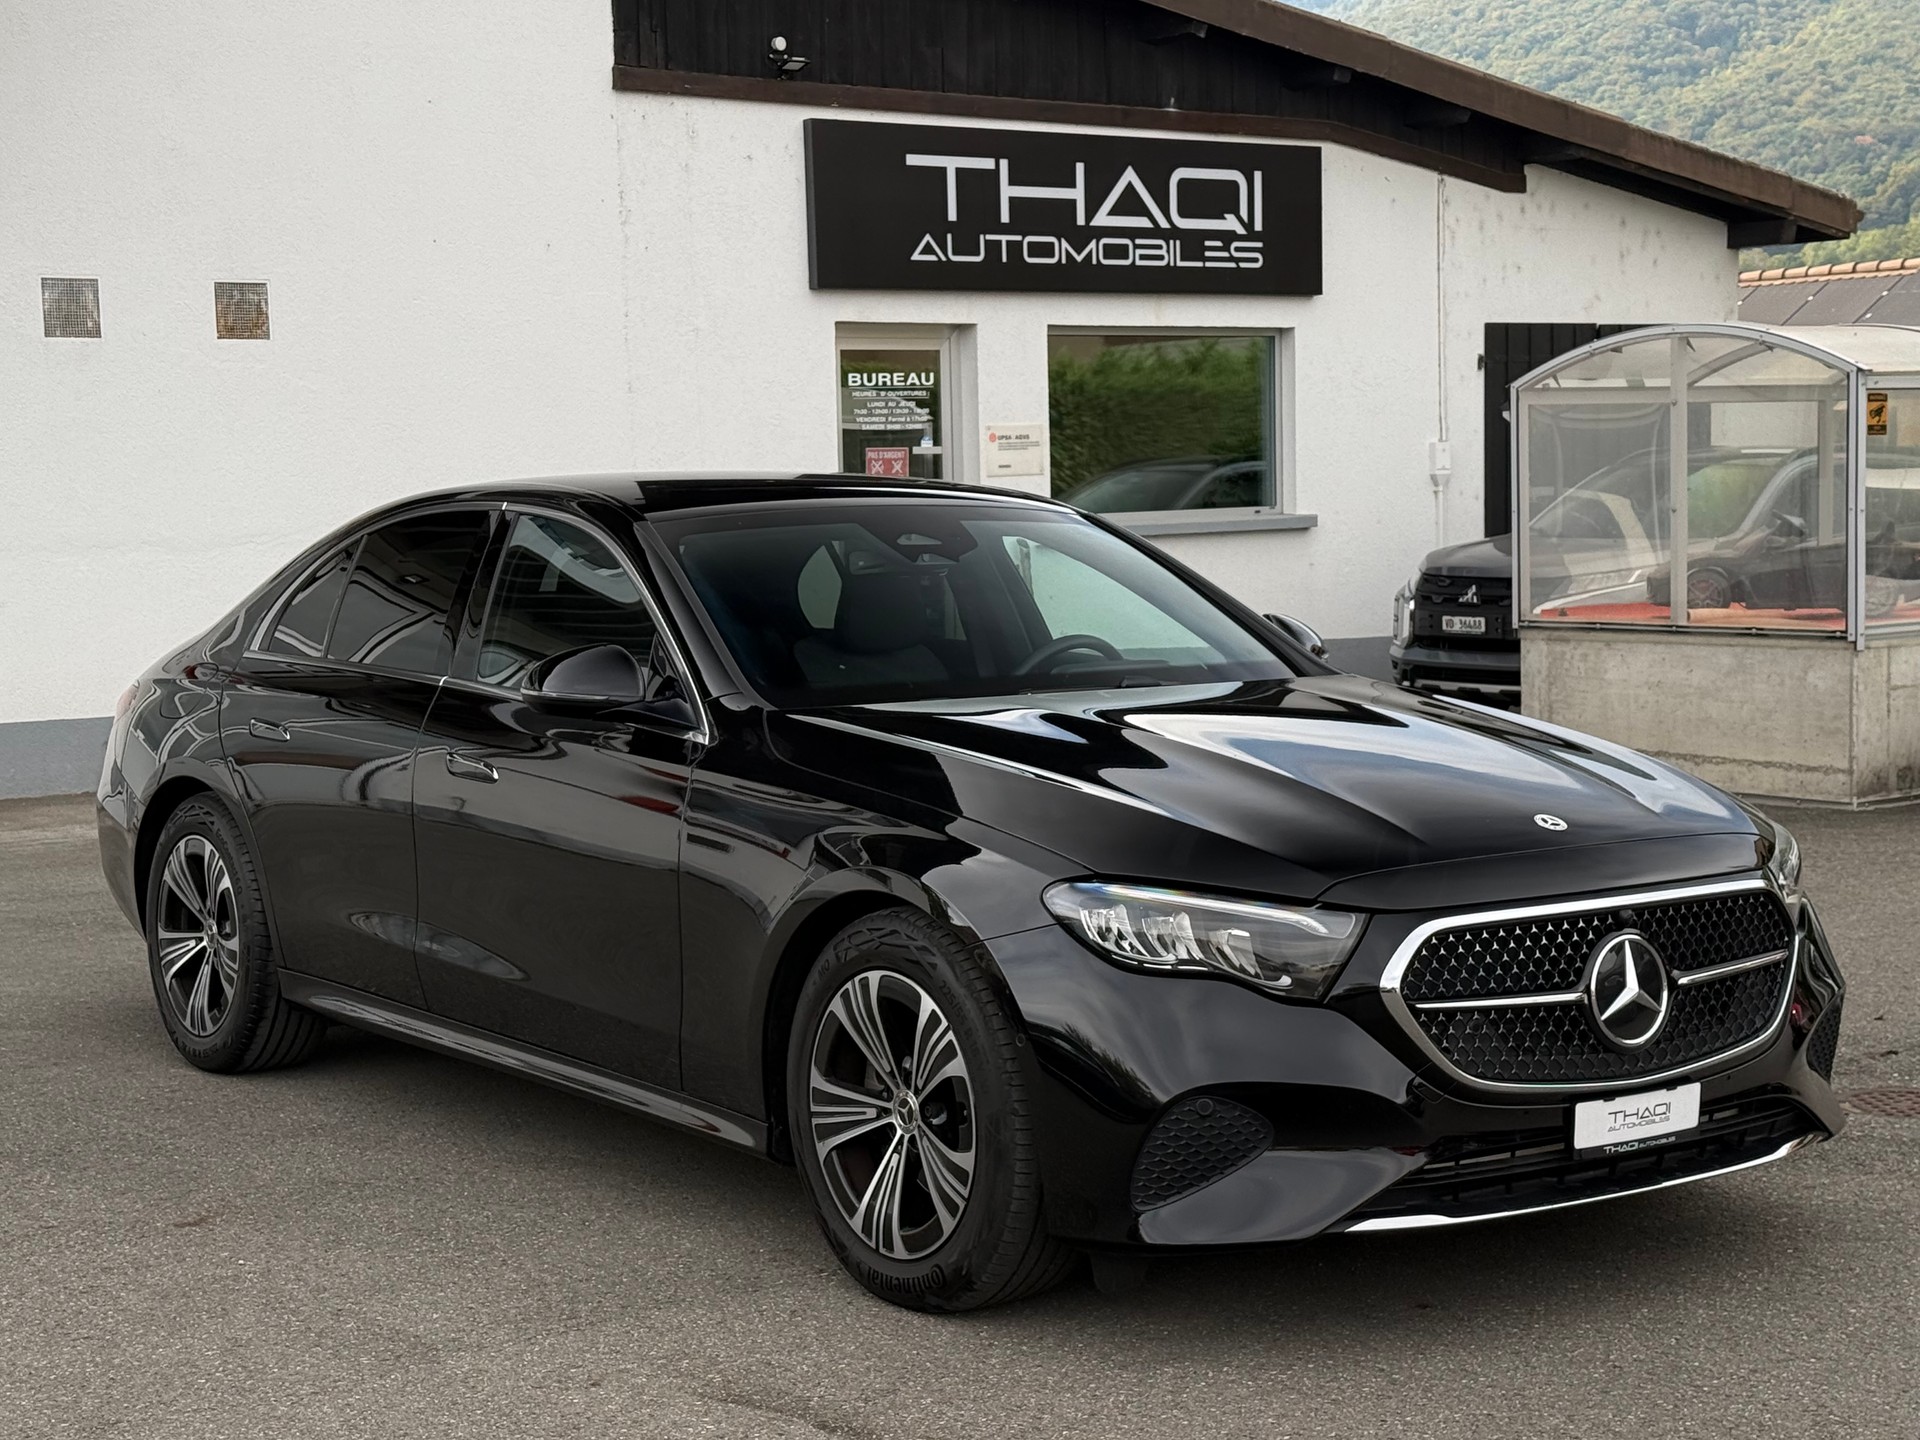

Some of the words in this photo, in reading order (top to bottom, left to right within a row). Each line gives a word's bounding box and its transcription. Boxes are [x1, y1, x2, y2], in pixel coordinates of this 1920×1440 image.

[905, 153, 1263, 235] THAQI
[909, 232, 1264, 269] AUTOMOBILES
[848, 372, 934, 386] BUREAU
[867, 451, 878, 459] PAS
[1608, 1102, 1671, 1124] THAQI
[1607, 1115, 1671, 1133] AUTOMOBILES
[1603, 1142, 1639, 1154] THAQI
[867, 1264, 947, 1296] Continental
